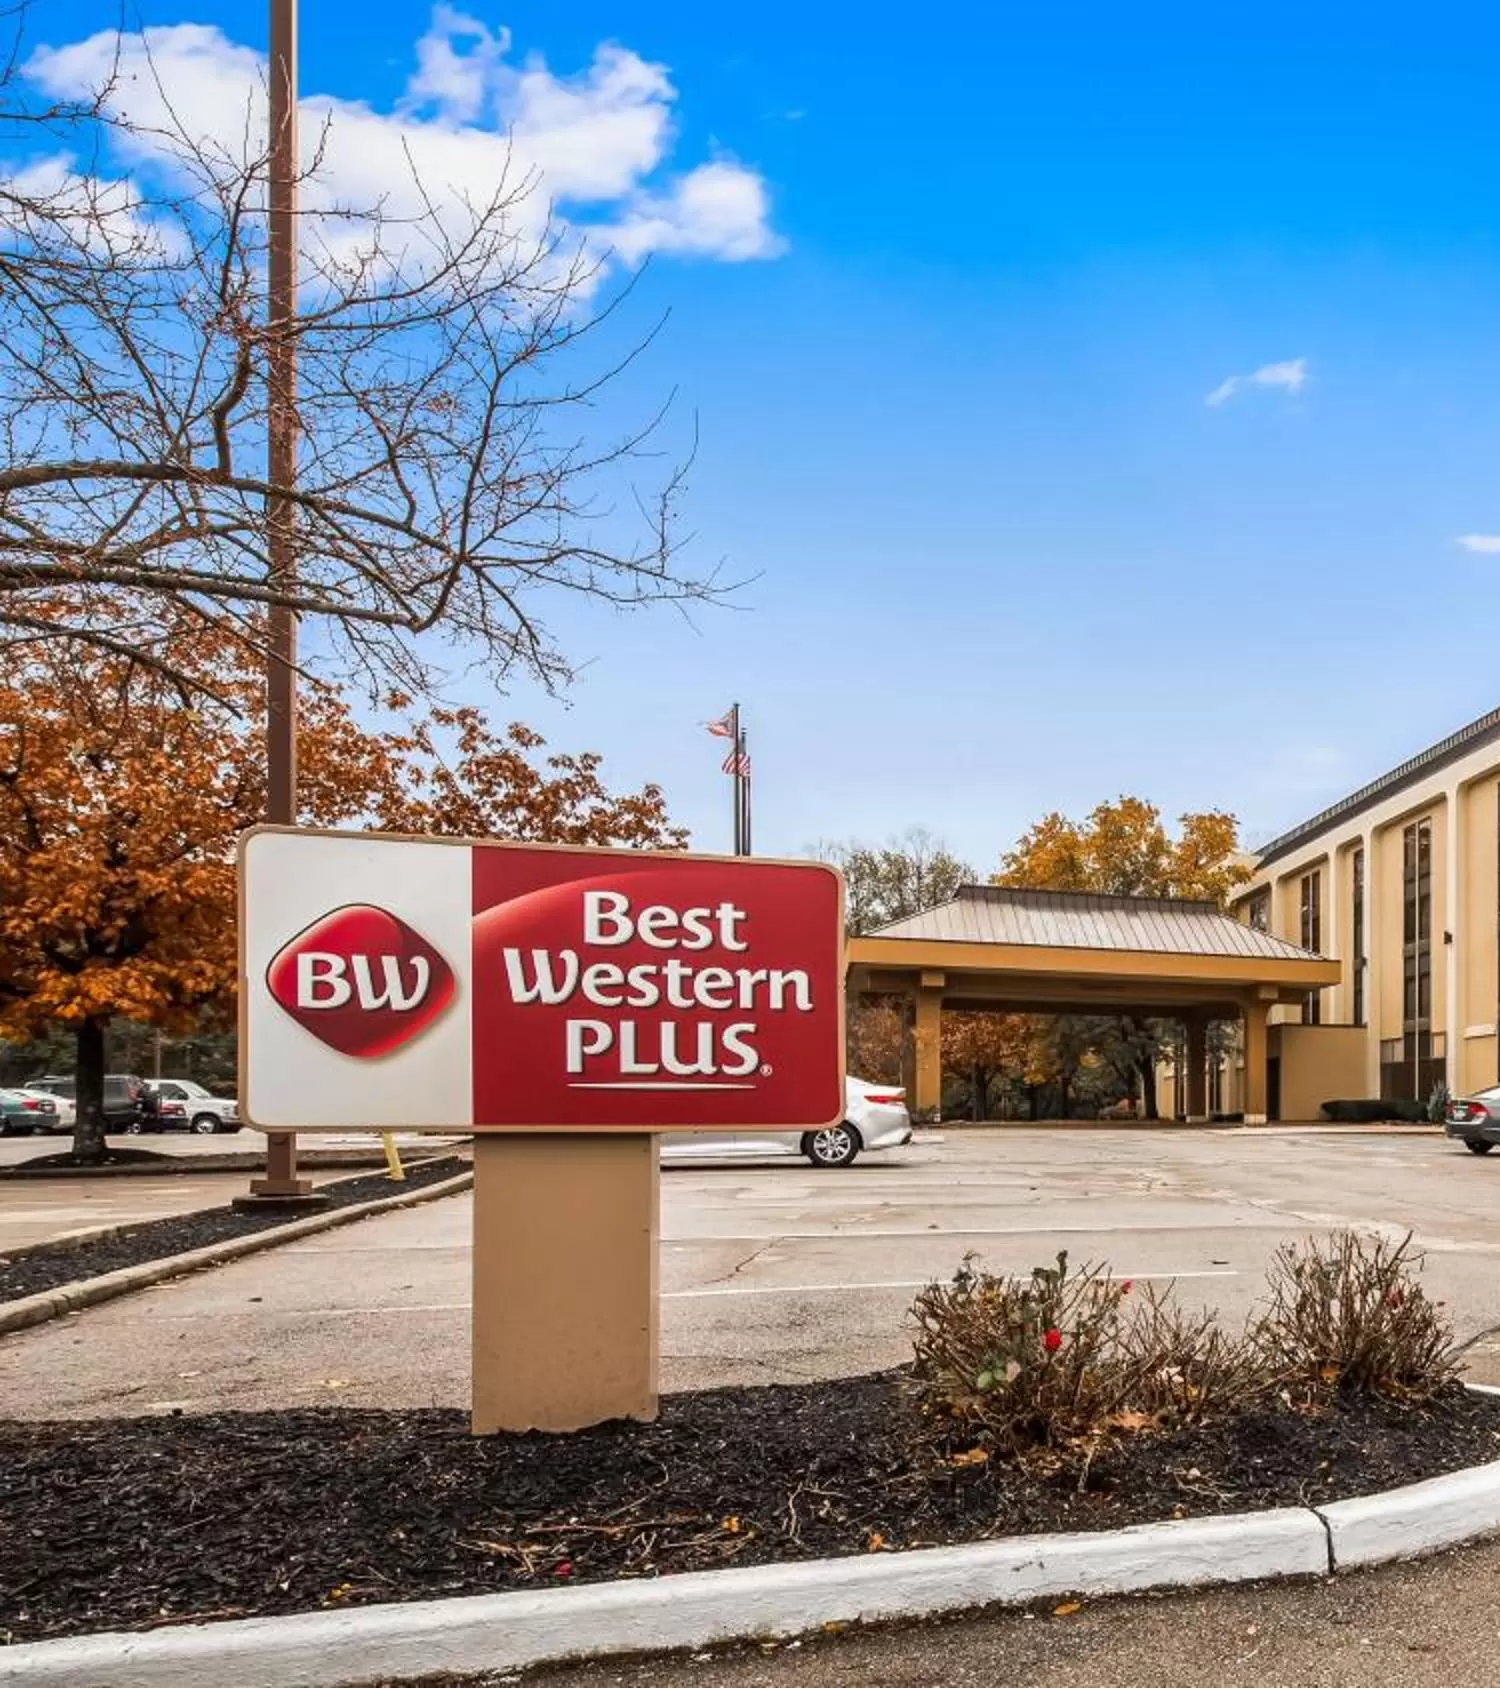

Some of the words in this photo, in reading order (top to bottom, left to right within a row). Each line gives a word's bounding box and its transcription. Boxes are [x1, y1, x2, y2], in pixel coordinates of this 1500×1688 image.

[583, 891, 748, 951] Best
[297, 952, 430, 1012] BW
[503, 947, 814, 1011] Western
